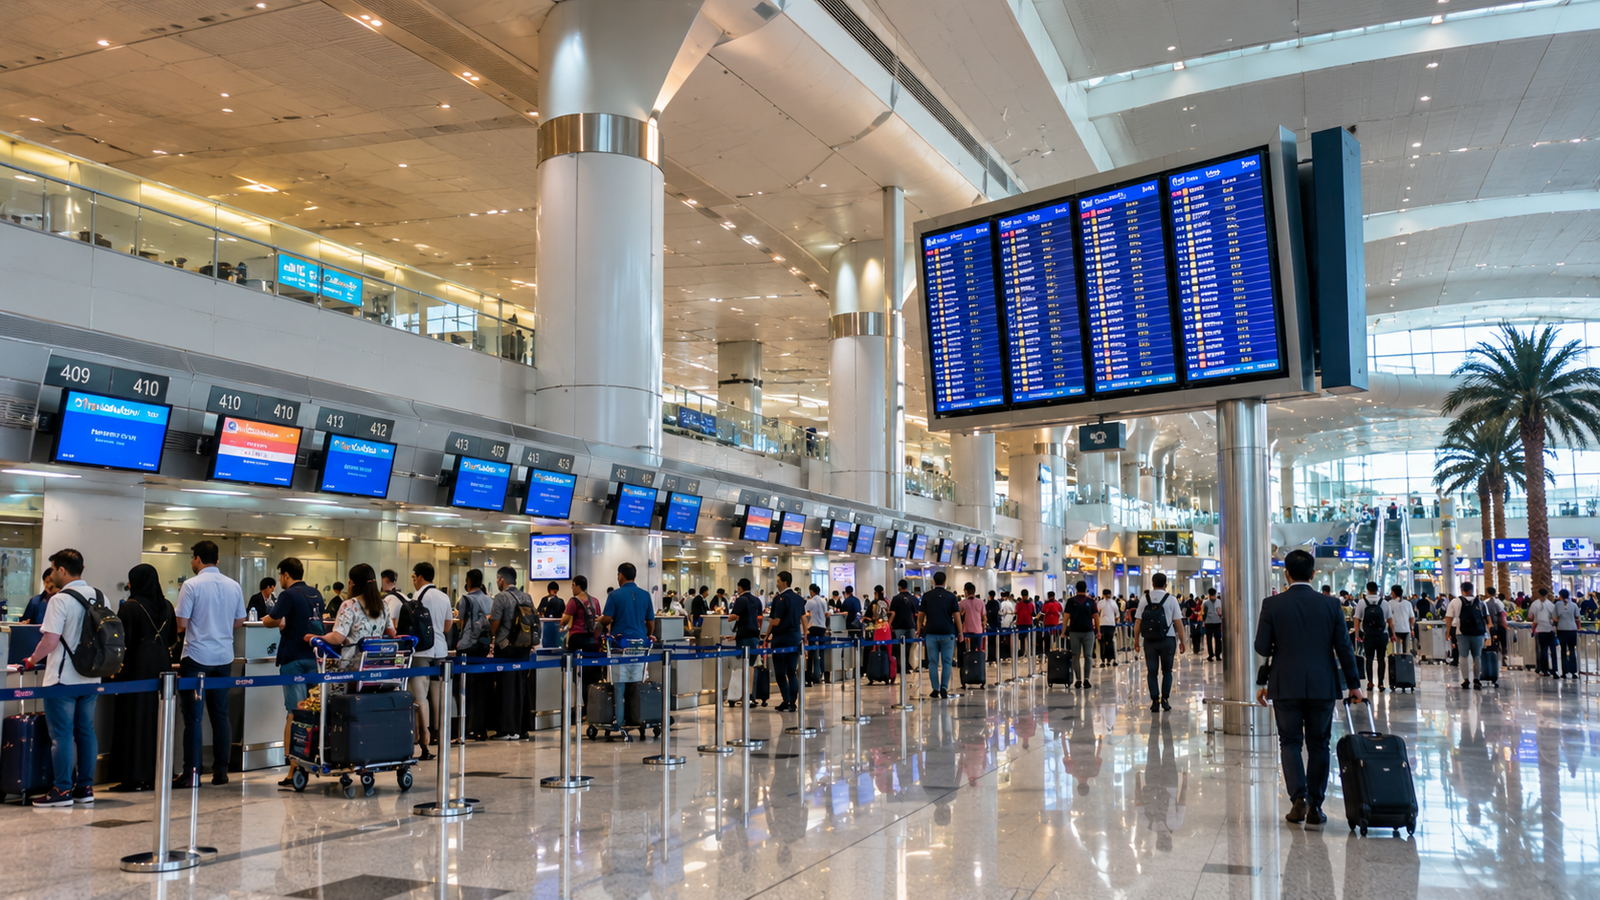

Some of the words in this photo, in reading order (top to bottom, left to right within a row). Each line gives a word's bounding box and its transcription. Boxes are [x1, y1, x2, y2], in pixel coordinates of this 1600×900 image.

[60, 364, 91, 384] 409
[133, 378, 160, 397] 410
[218, 393, 241, 411] 410
[273, 403, 294, 420] 410
